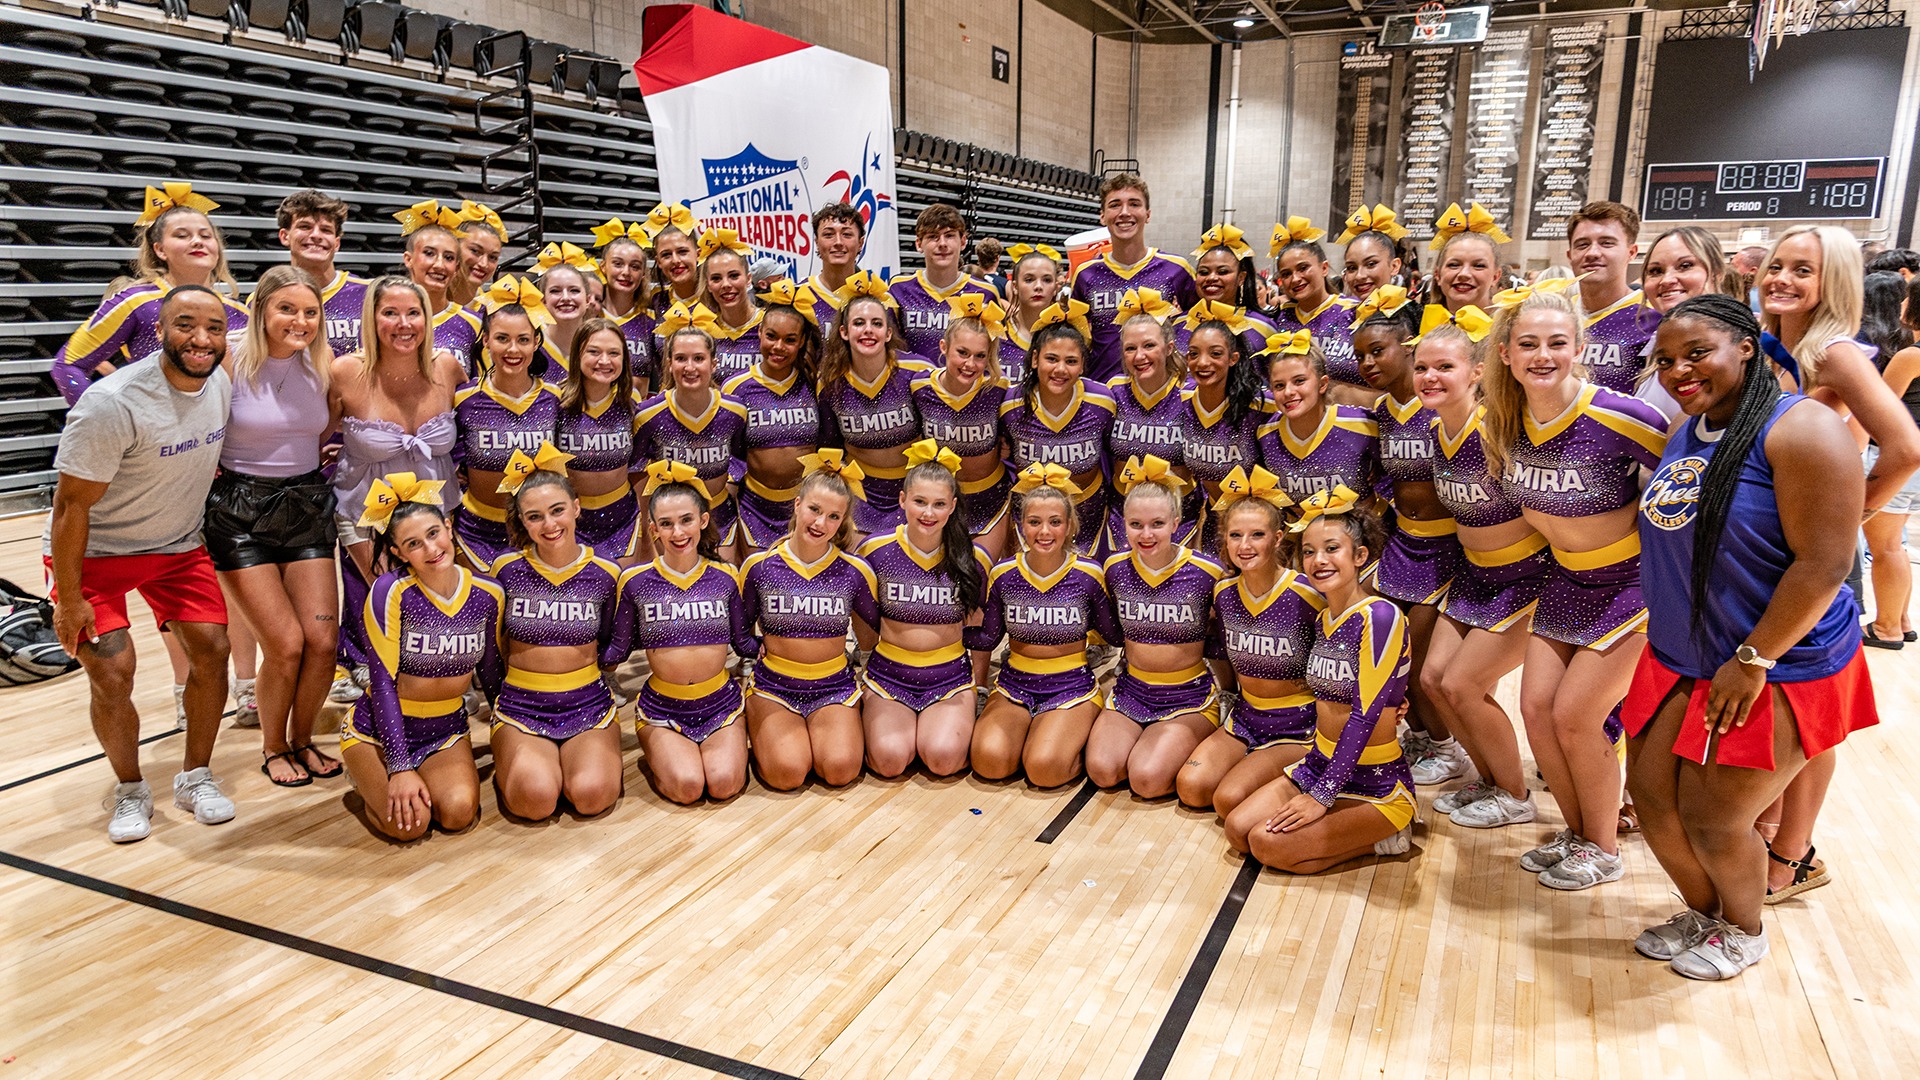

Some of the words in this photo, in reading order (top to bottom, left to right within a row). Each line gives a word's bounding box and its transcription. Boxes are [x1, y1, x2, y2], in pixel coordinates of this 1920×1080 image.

[1483, 36, 1529, 46] OURNAMENT
[1552, 32, 1600, 41] CONFERENCE
[1553, 39, 1598, 48] CHAMPIONS
[1411, 47, 1454, 56] CHAMPIONS
[718, 180, 793, 215] NATIONAL
[1726, 200, 1762, 213] PERIOD
[906, 311, 950, 330] ELMI
[748, 407, 818, 427] ELMIRA
[841, 408, 914, 433] ELMIRA
[160, 437, 199, 457] ELMIRA
[205, 426, 226, 445] CHEE
[478, 430, 555, 449] ELMIRA
[558, 431, 631, 451] ELMIRA
[924, 421, 994, 443] ELMIRA
[1111, 419, 1185, 445] ELMIRA
[663, 444, 730, 464] ELMIRA
[1018, 439, 1097, 464] ELMIRA
[1670, 460, 1706, 474] ELMIRA
[1640, 479, 1701, 511] Chee
[1648, 507, 1688, 527] COLLEGE
[511, 598, 597, 621] ELMIRA
[644, 600, 727, 623] ELMIRA
[767, 595, 845, 616] ELMIRA
[1007, 604, 1082, 626] ELMIRA
[1118, 603, 1195, 624] ELMIRA
[406, 631, 486, 654] ELMIRA
